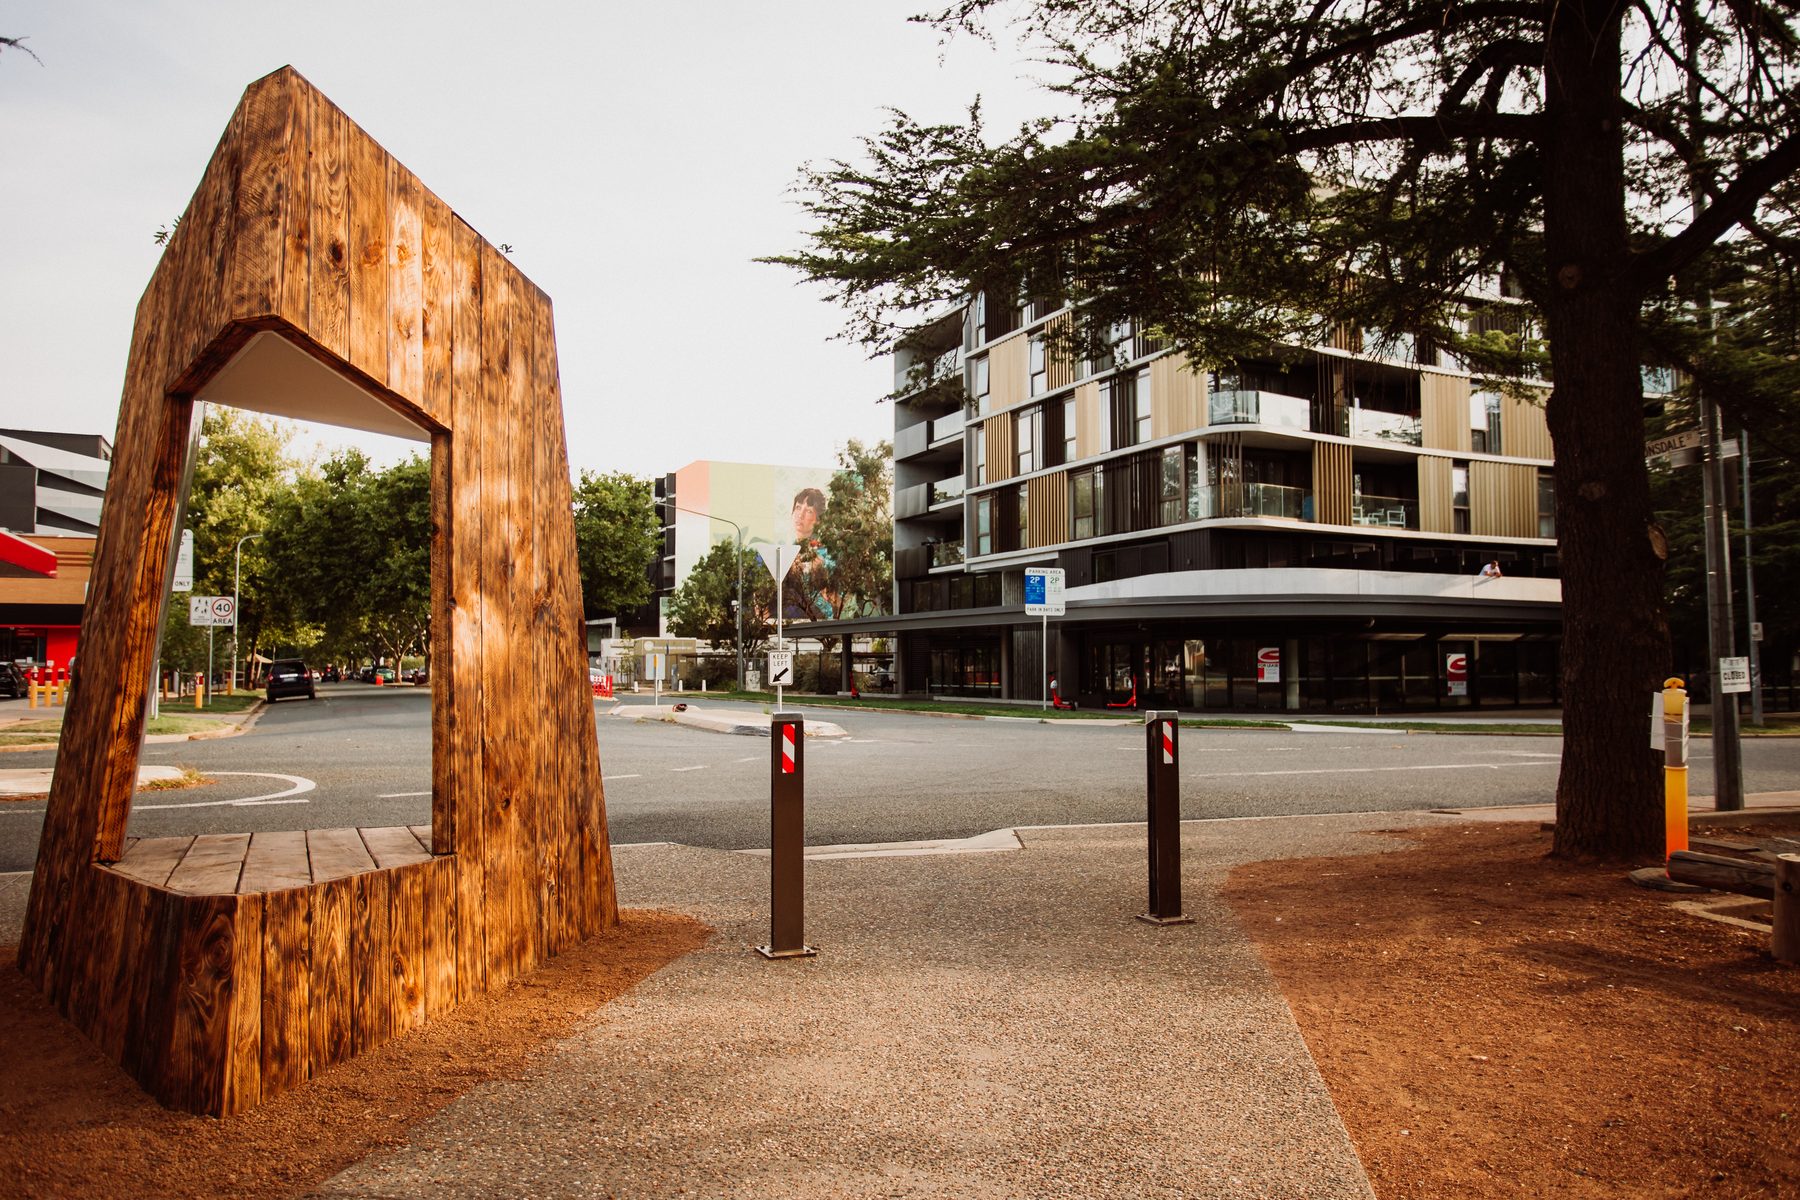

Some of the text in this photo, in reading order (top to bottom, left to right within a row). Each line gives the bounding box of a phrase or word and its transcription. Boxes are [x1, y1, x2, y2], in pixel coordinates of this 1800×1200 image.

[1029, 576, 1041, 584] 2P
[1050, 576, 1060, 584] 2P
[215, 603, 231, 613] 40
[1723, 671, 1745, 681] CLOSED
